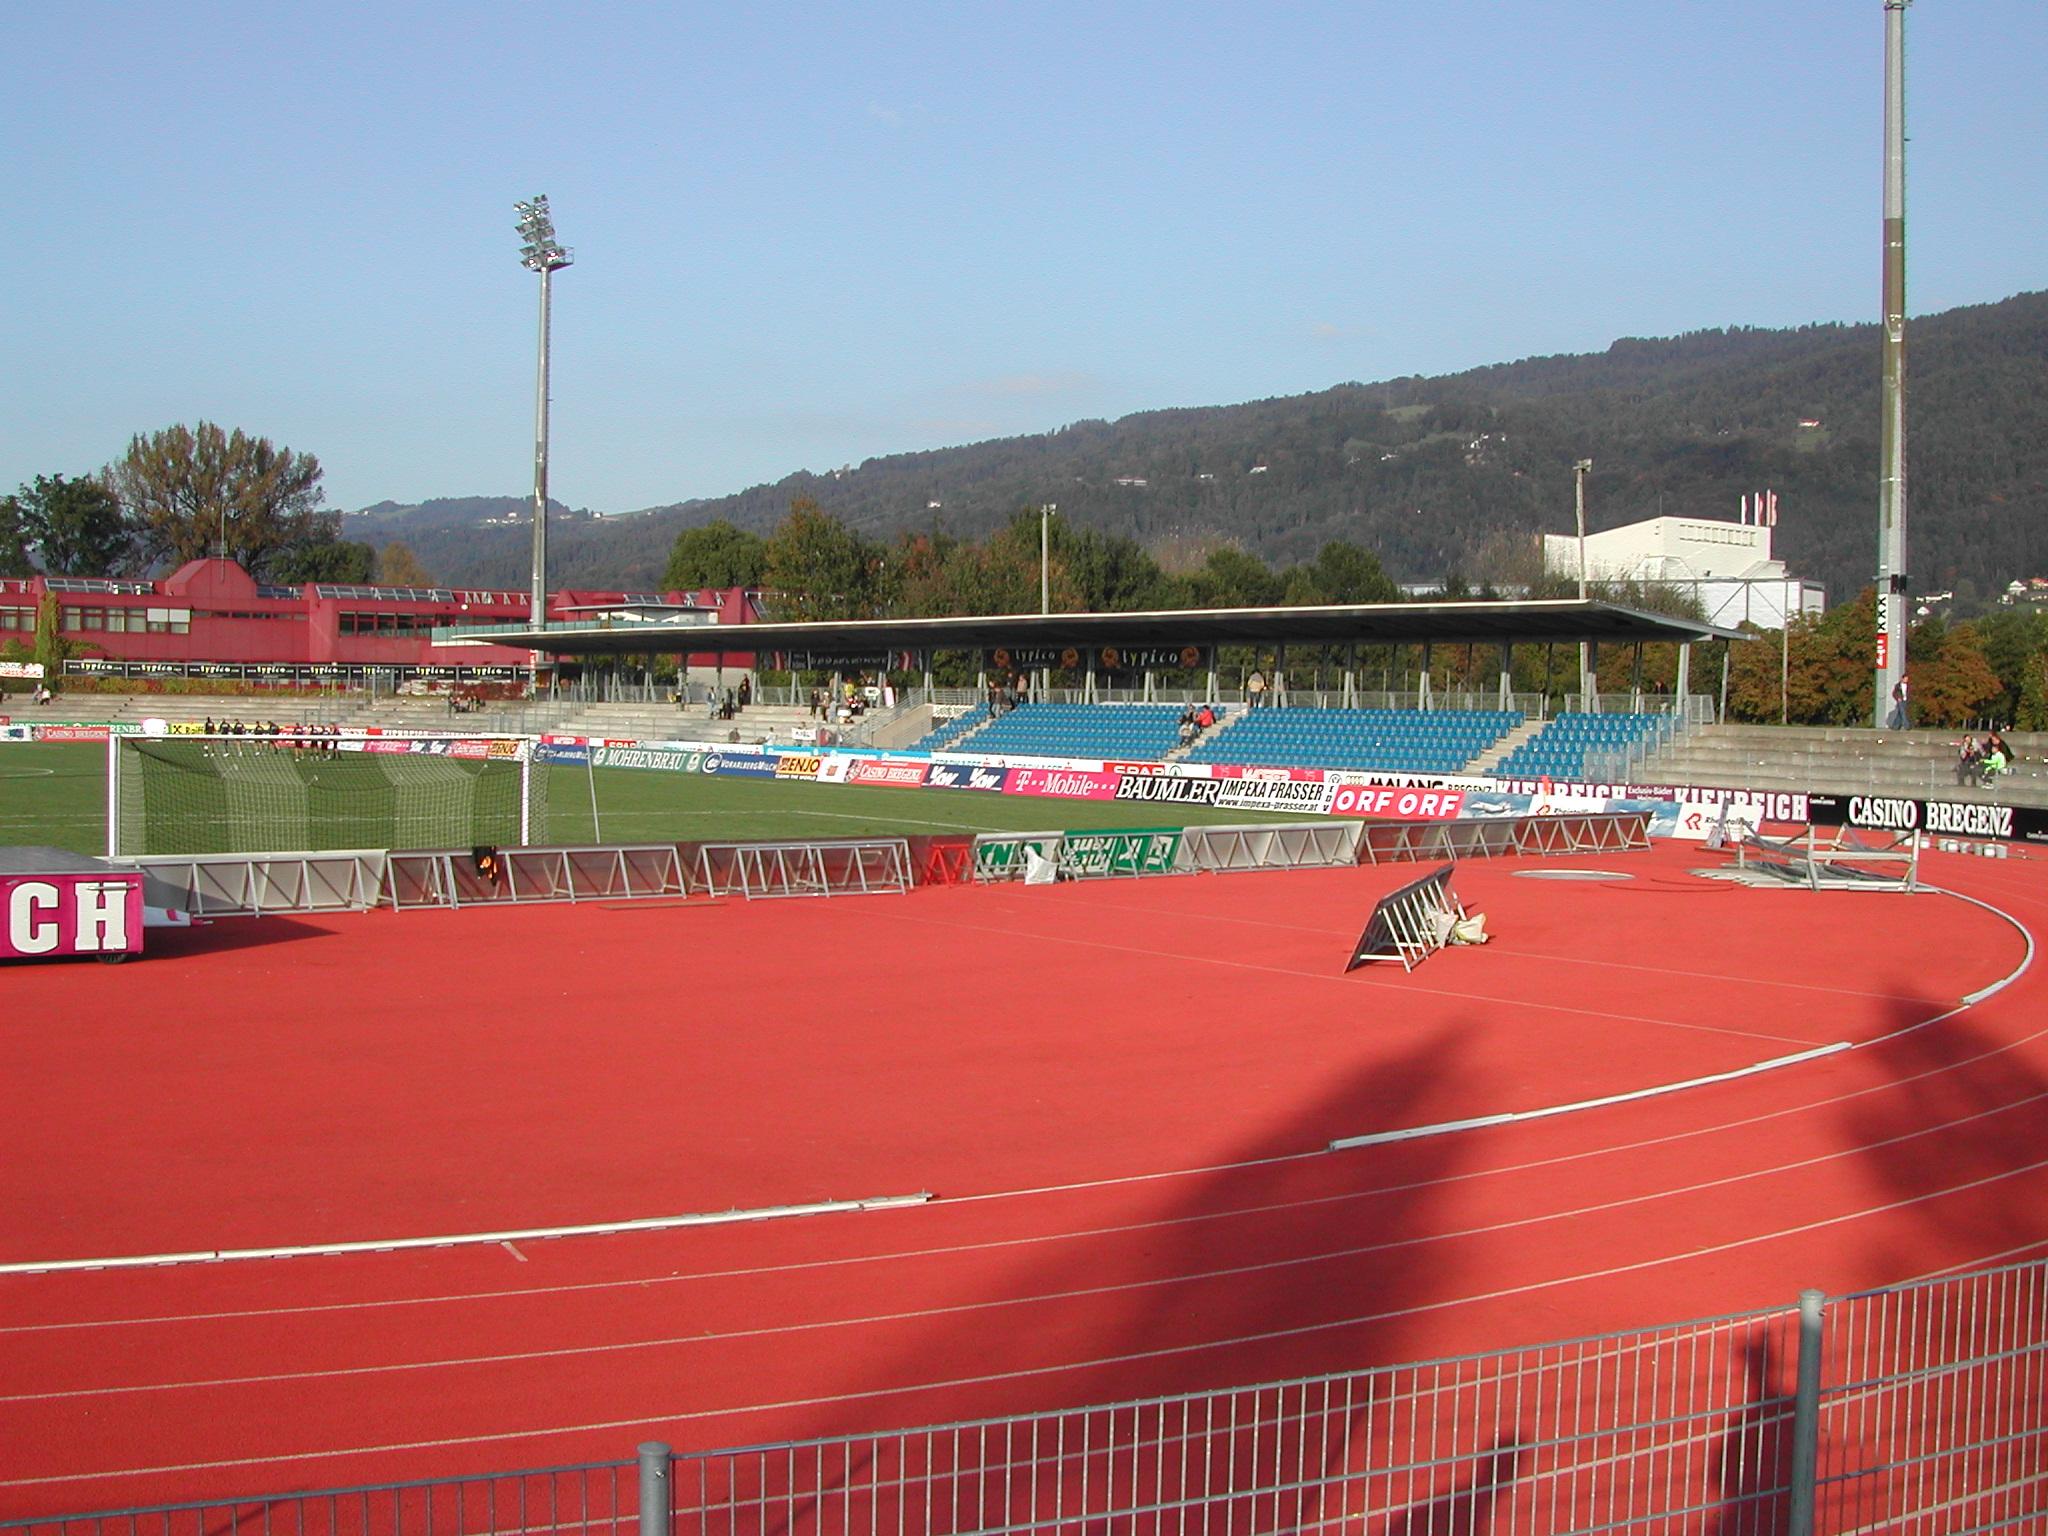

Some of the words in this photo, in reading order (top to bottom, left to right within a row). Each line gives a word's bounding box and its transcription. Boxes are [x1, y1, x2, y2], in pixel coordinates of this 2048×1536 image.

[1121, 649, 1179, 665] typico
[788, 757, 821, 773] ENJO
[860, 764, 887, 778] CASINO
[1222, 779, 1267, 799] IMPEXA
[1268, 782, 1324, 801] PRASSER
[1218, 798, 1318, 812] www.impexa-prasser.at
[1336, 789, 1394, 813] ORF
[1397, 792, 1460, 817] ORF
[1849, 796, 1918, 828] CASINO
[1925, 801, 2014, 837] BREGENZ
